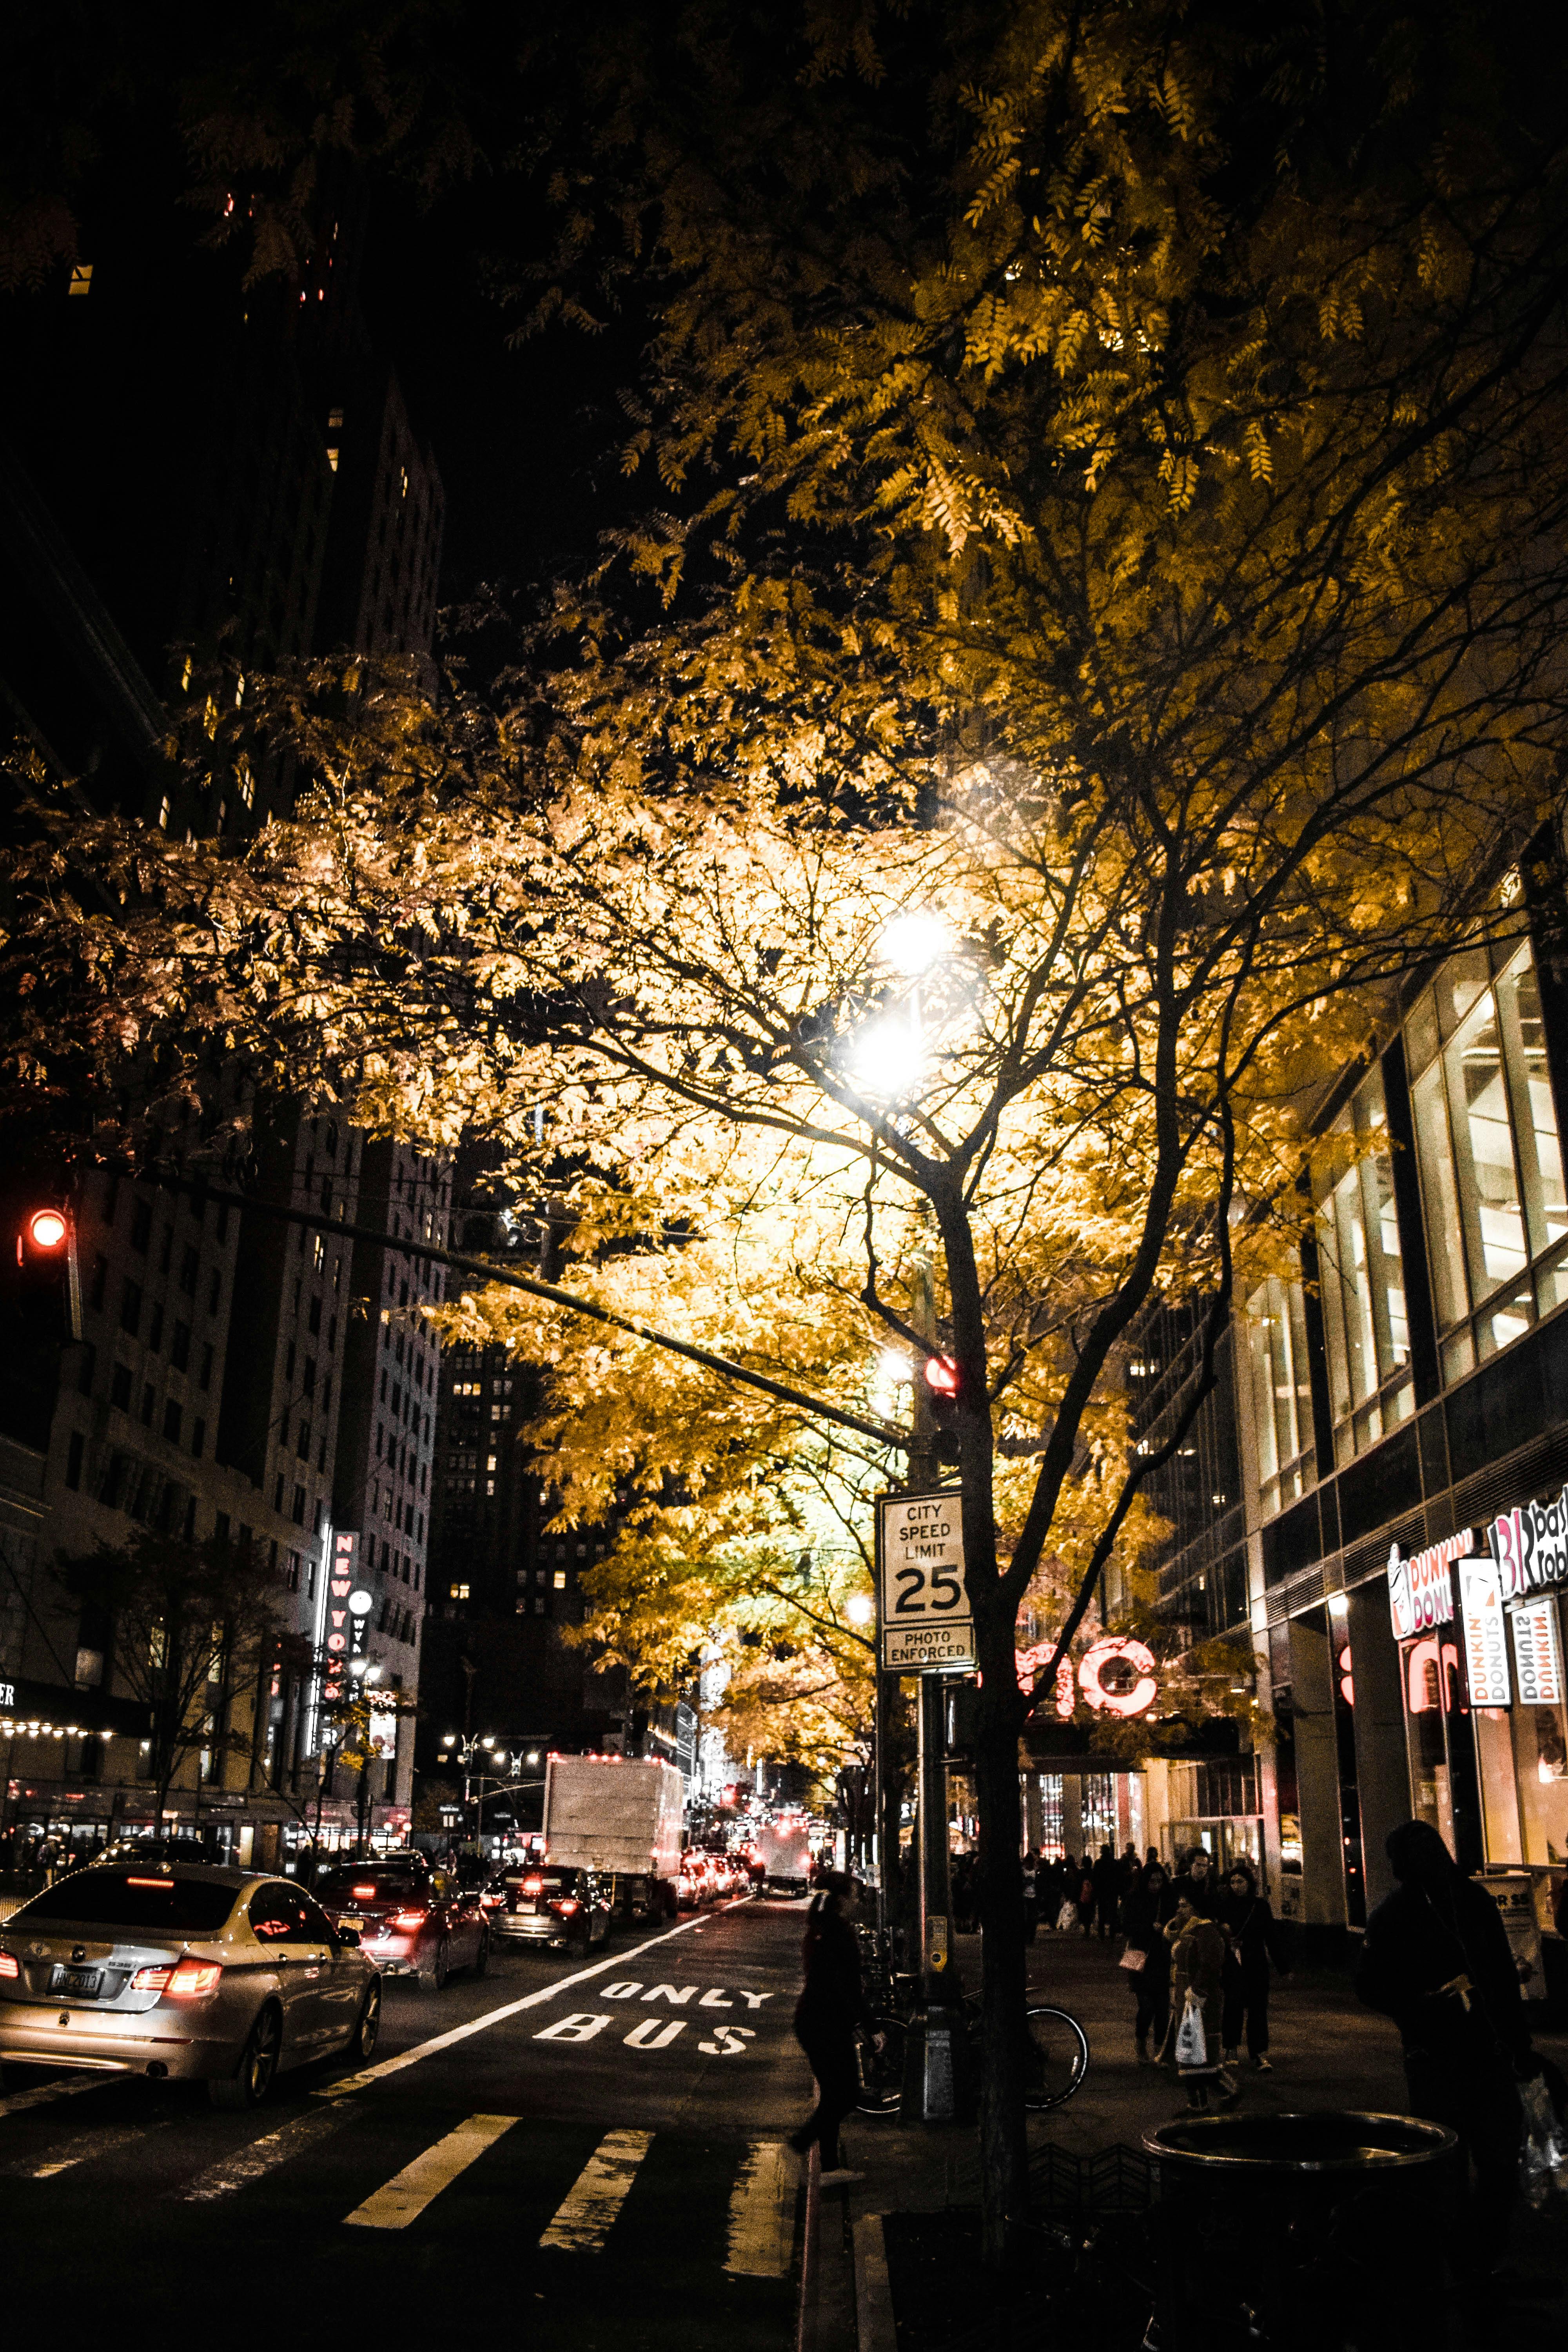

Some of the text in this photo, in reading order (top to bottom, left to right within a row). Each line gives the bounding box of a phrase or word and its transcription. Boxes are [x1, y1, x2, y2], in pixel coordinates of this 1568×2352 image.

[907, 1504, 942, 1521] CITY
[900, 1523, 951, 1541] SPEED
[906, 1543, 946, 1560] LIMIT
[331, 1535, 352, 1597] NEW
[895, 1564, 961, 1613] 25
[905, 1631, 951, 1645] PHOTO
[891, 1645, 965, 1661] ENFORCED
[1468, 1612, 1488, 1700] DUNKIN'
[1485, 1617, 1505, 1699] DONUTS
[599, 1982, 774, 2008] ONLY
[532, 2013, 756, 2054] BUS
